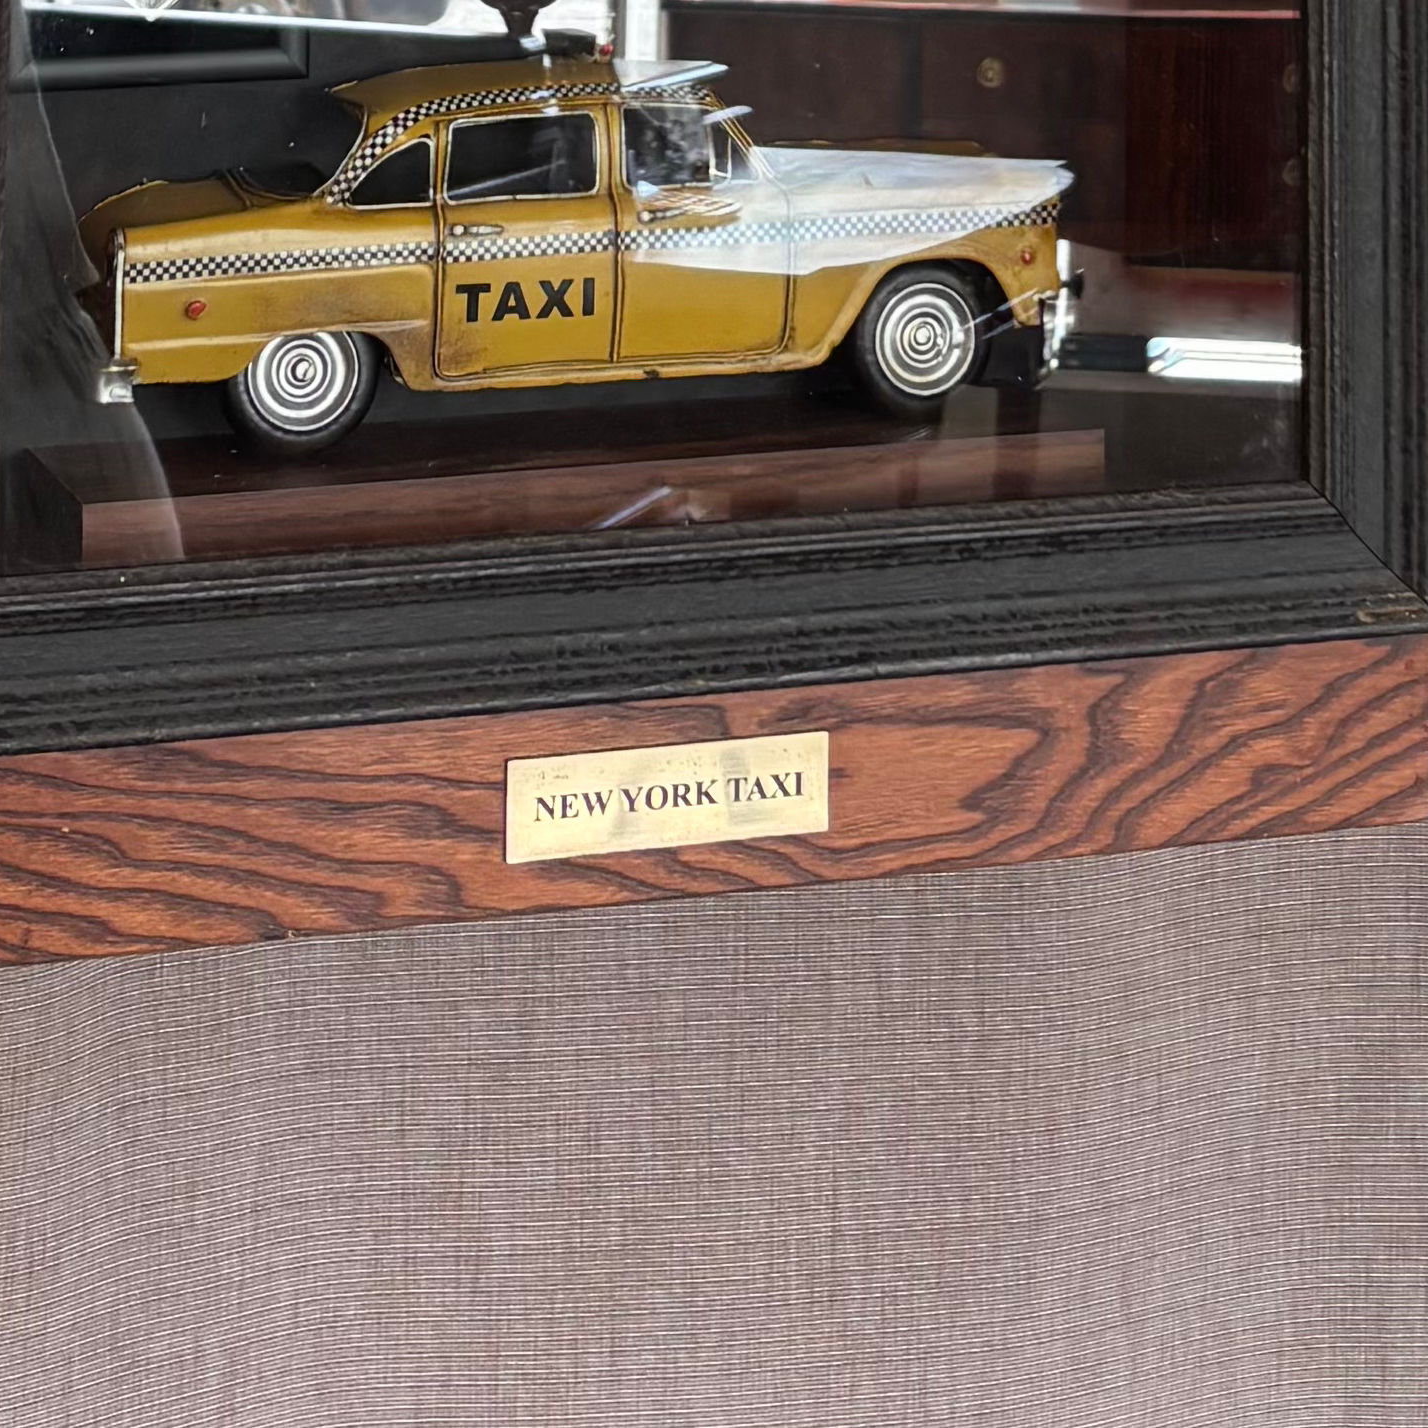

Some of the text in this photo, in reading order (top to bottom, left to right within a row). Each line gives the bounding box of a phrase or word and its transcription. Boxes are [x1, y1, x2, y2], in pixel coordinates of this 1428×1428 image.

[455, 277, 596, 323] TAXI
[533, 770, 805, 822] NEW YORK TAXI
